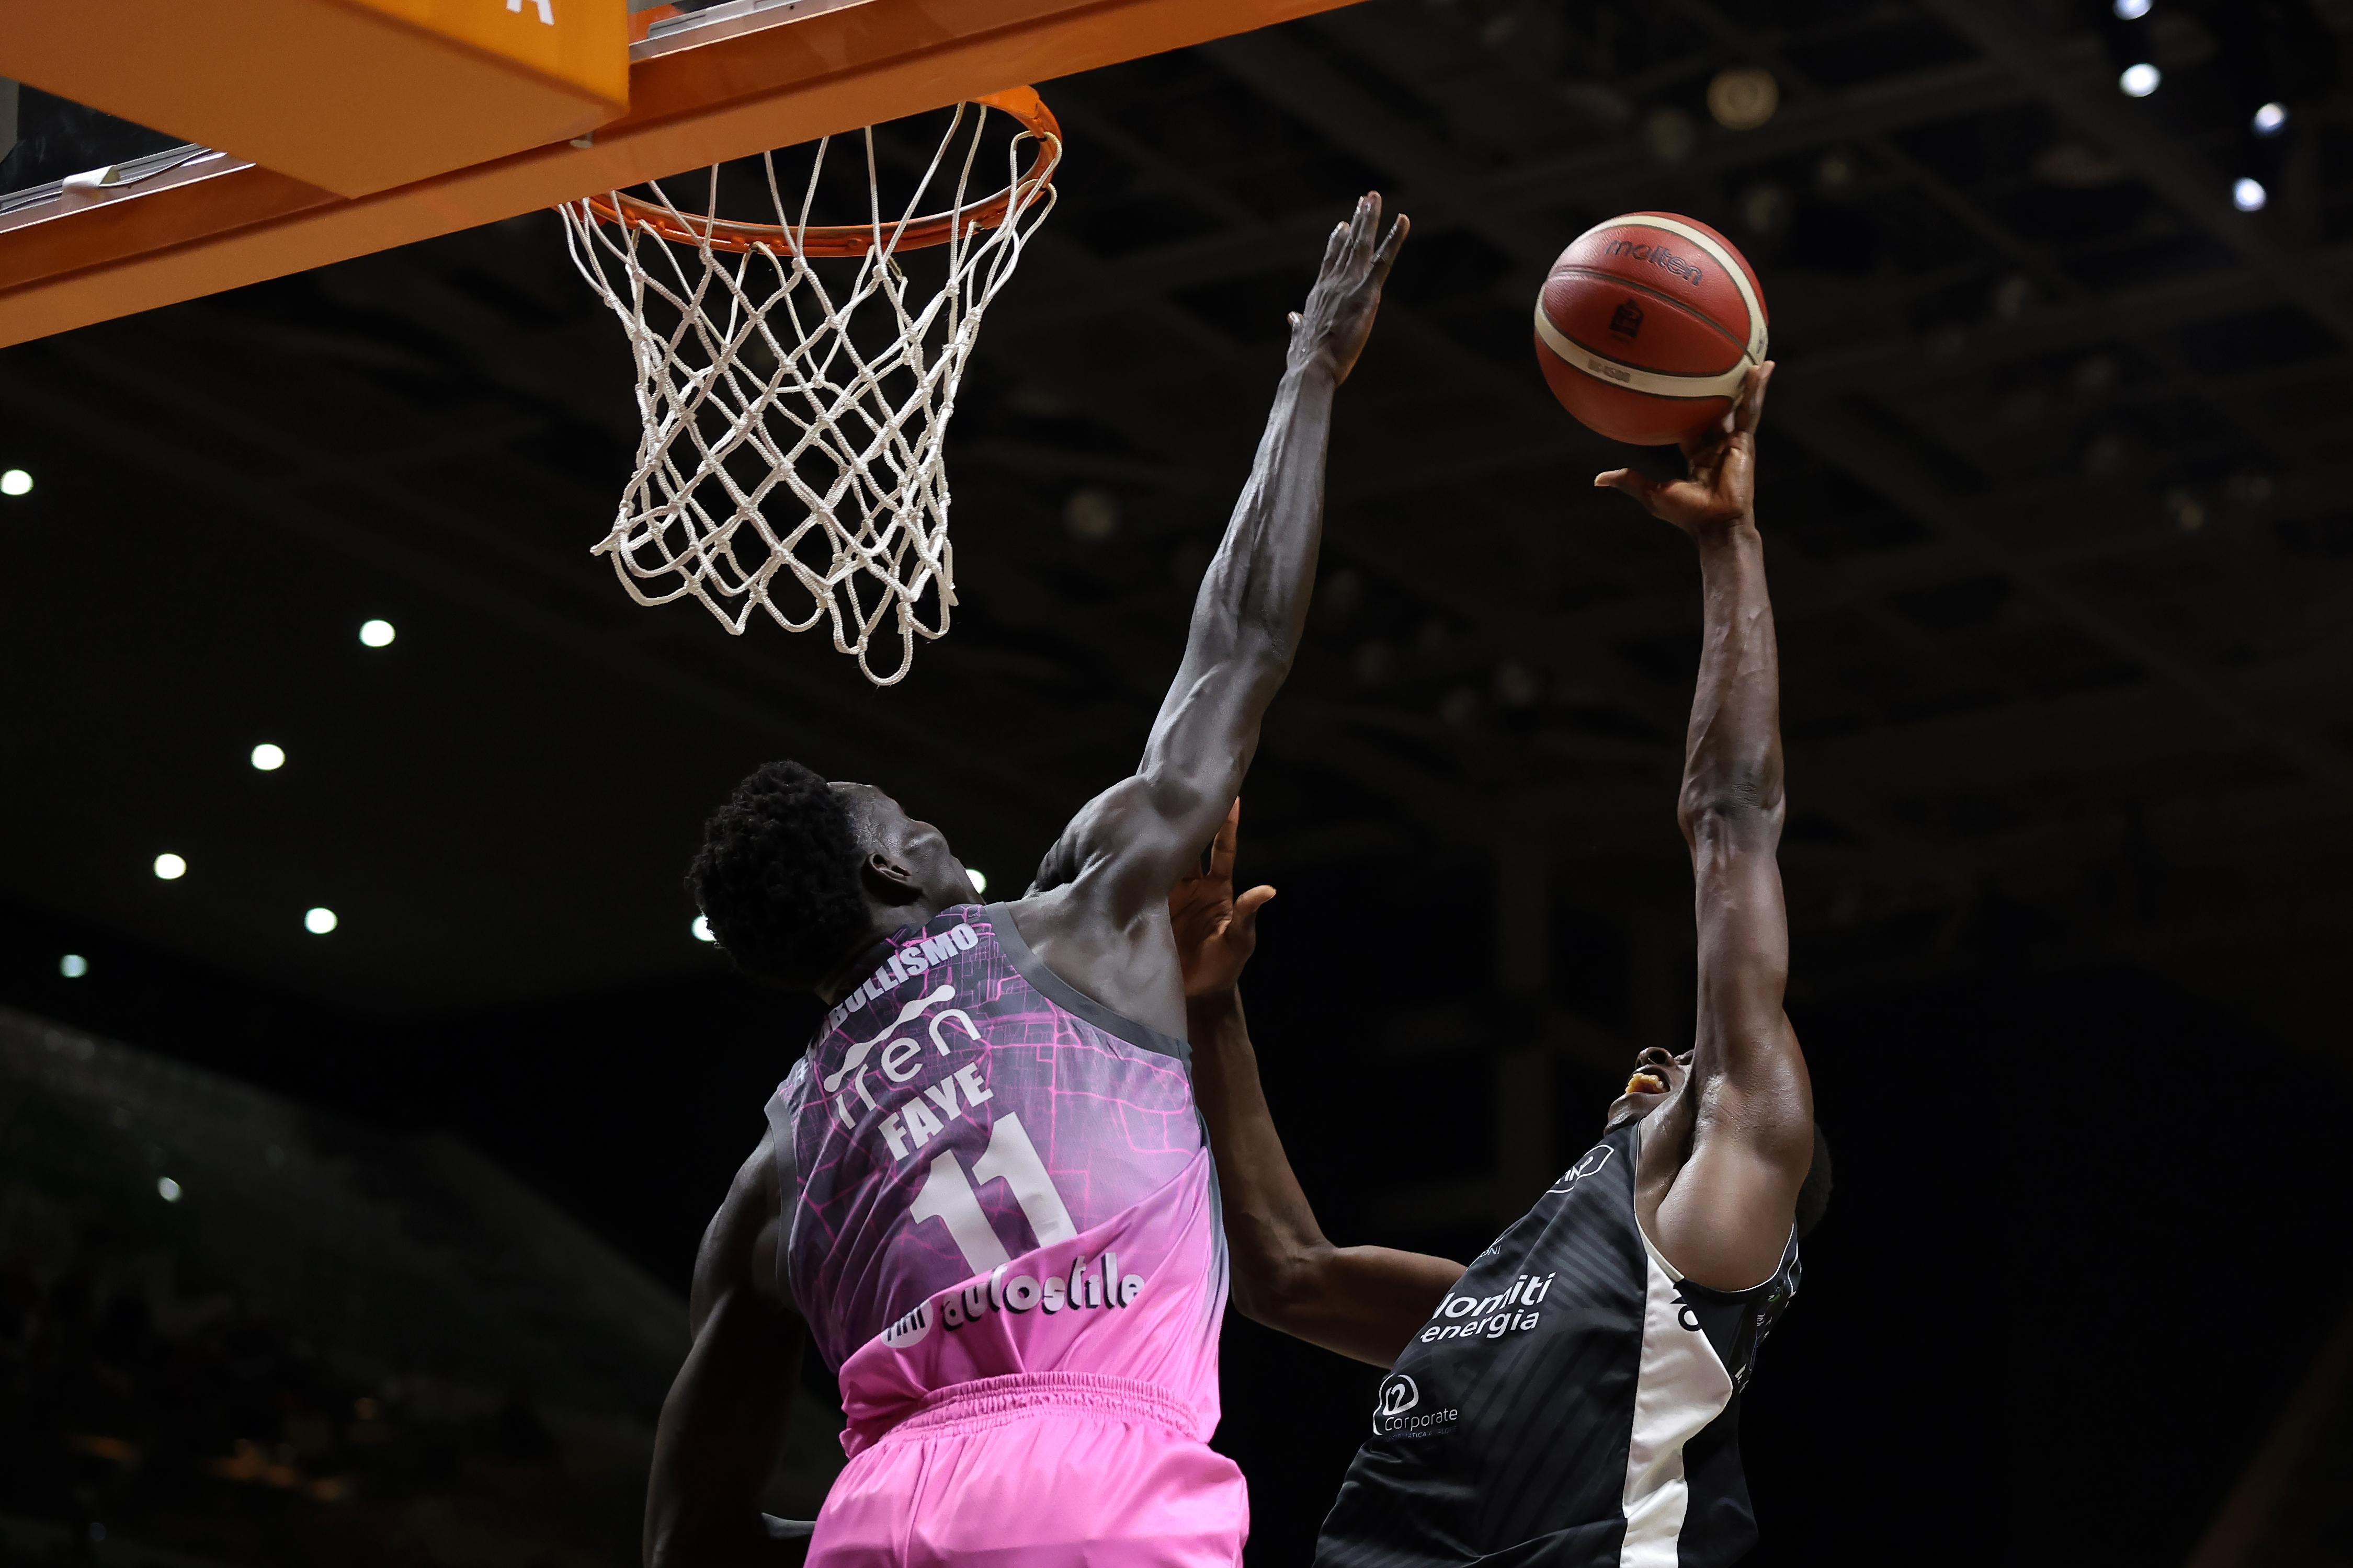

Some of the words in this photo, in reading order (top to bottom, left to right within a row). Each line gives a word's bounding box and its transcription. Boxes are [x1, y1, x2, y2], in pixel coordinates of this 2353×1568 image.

[1606, 239, 1703, 286] molten
[878, 1062, 994, 1161] FAYE
[909, 1111, 1078, 1277] 11
[941, 1252, 1146, 1331] autostile
[1420, 1309, 1540, 1343] energia
